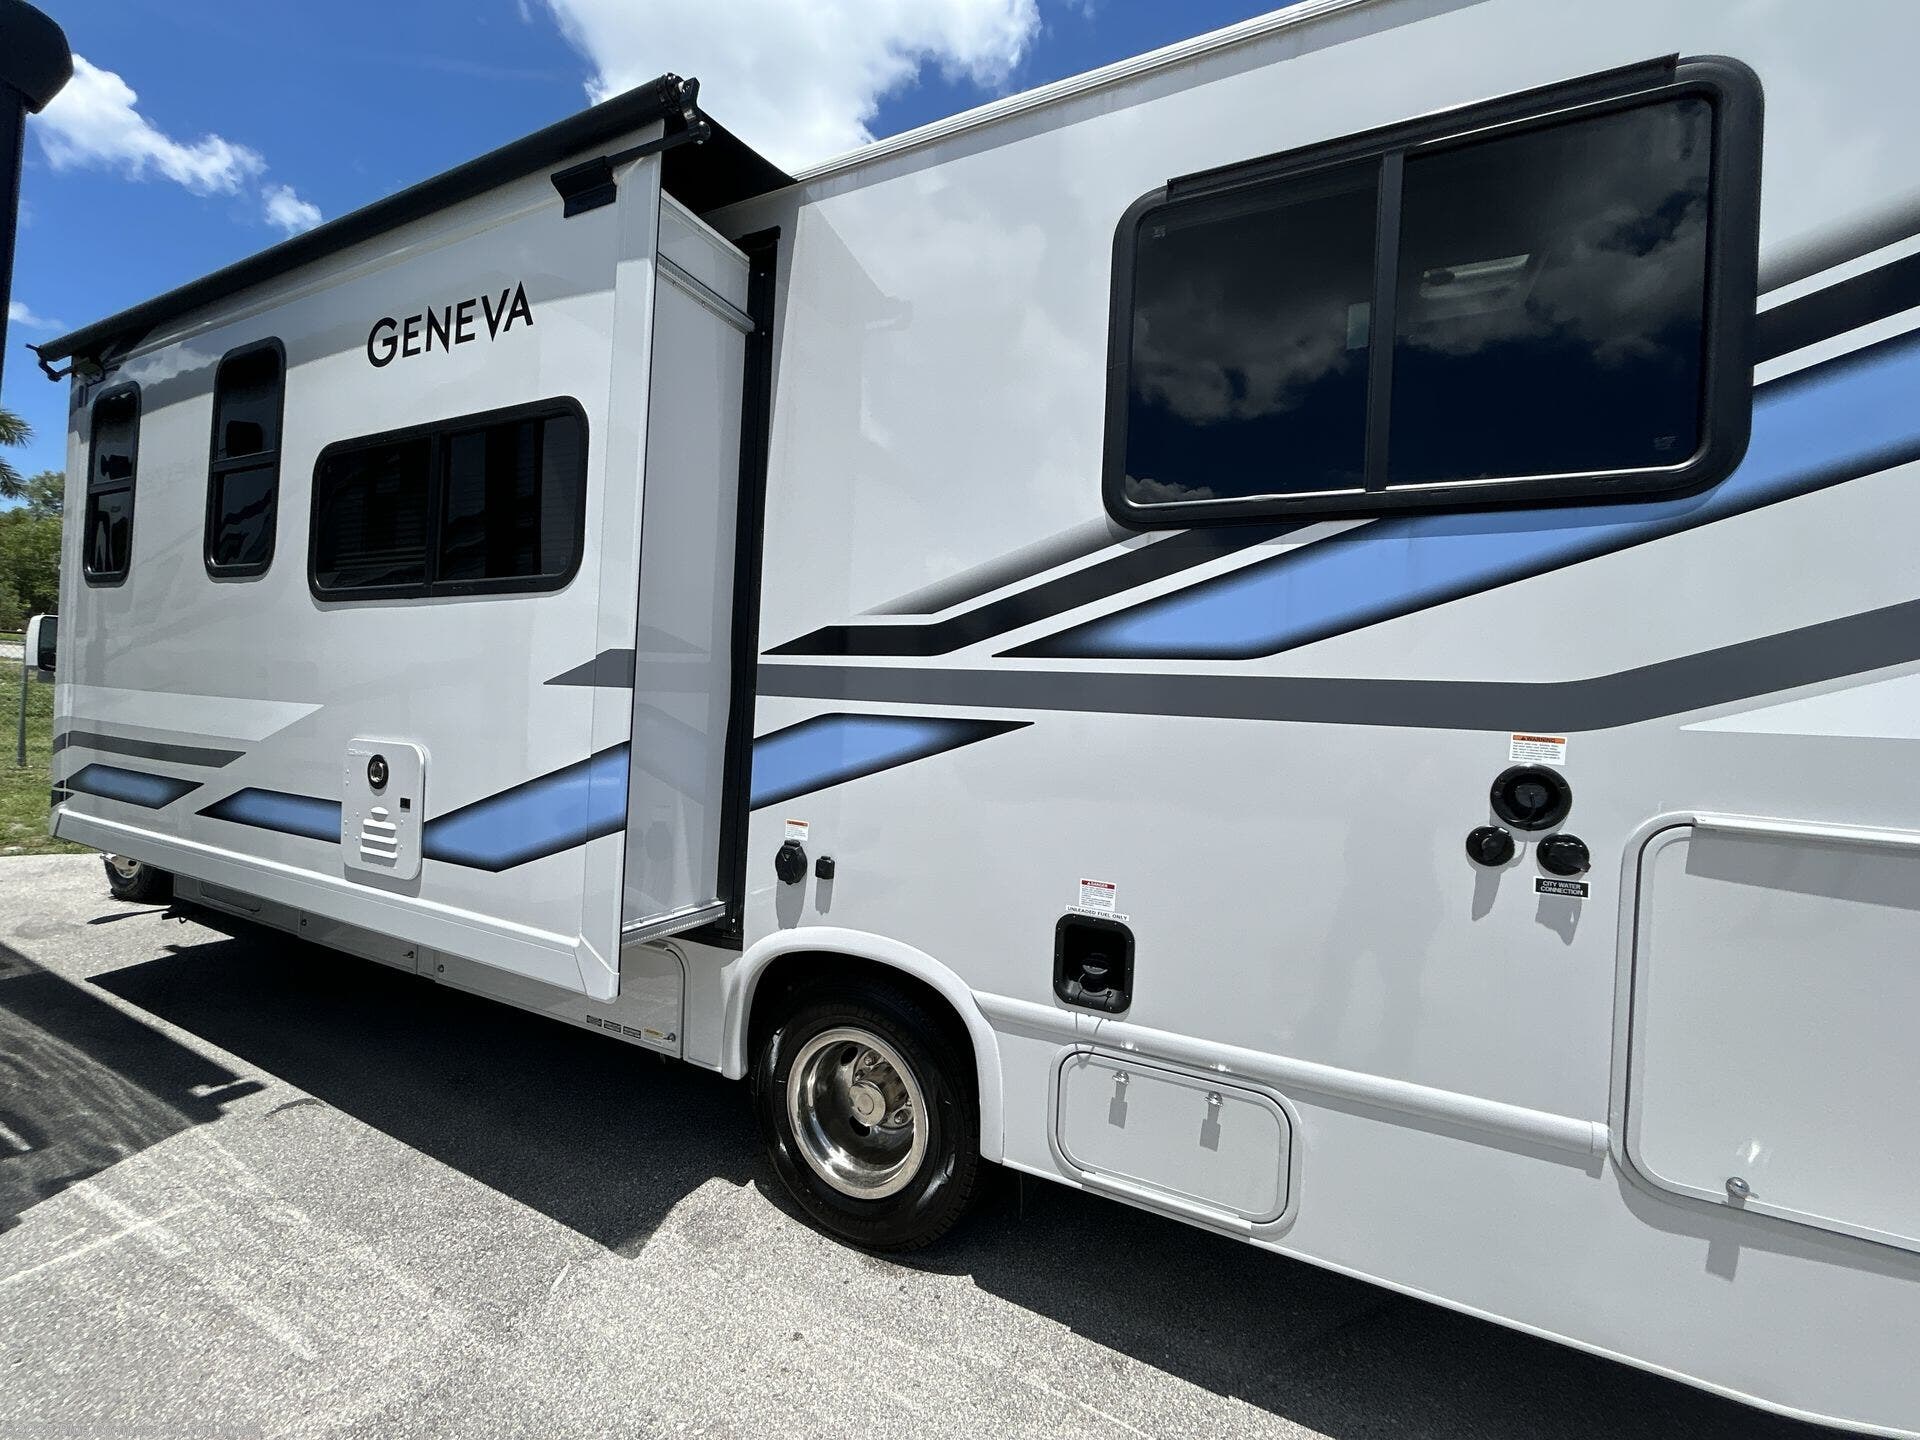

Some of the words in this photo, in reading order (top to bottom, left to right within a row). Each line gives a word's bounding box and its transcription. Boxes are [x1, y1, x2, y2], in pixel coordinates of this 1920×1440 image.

[367, 280, 534, 368] GENEVA
[1540, 886, 1584, 896] CONNECTION
[1558, 881, 1581, 890] WATER
[1067, 906, 1096, 915] UNLEADED
[1112, 913, 1128, 921] ONLY
